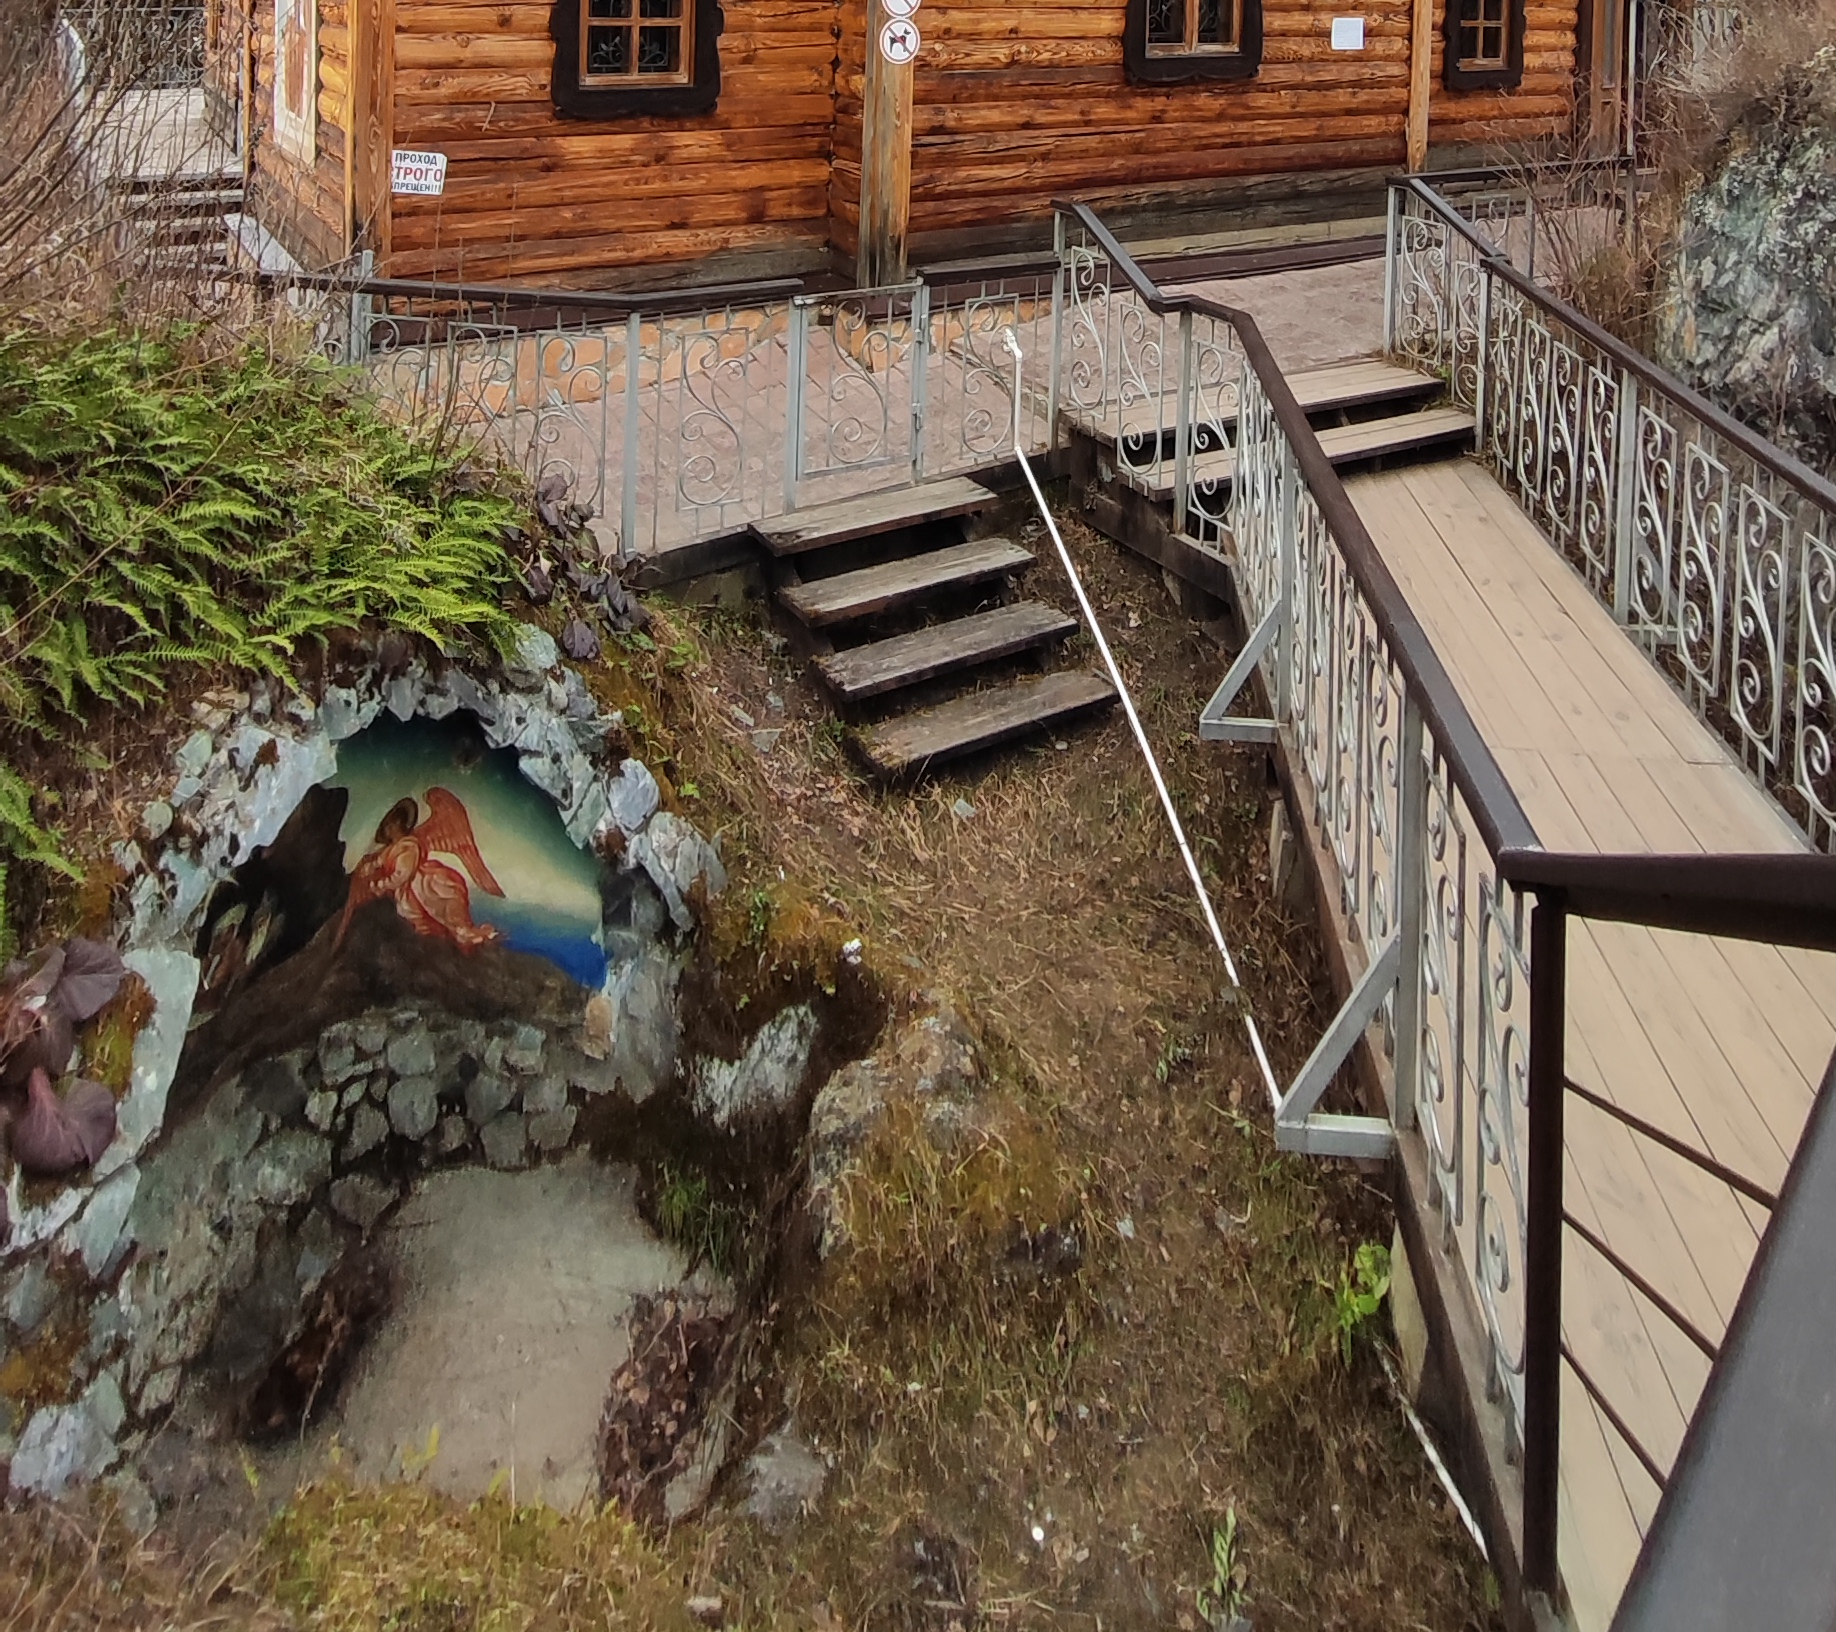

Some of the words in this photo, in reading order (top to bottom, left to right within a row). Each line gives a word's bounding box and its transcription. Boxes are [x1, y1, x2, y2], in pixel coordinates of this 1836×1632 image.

[394, 152, 437, 166] ПРОХОД
[391, 166, 443, 182] ТРОГО
[391, 181, 442, 193] ПРЕЩЕН!!!
